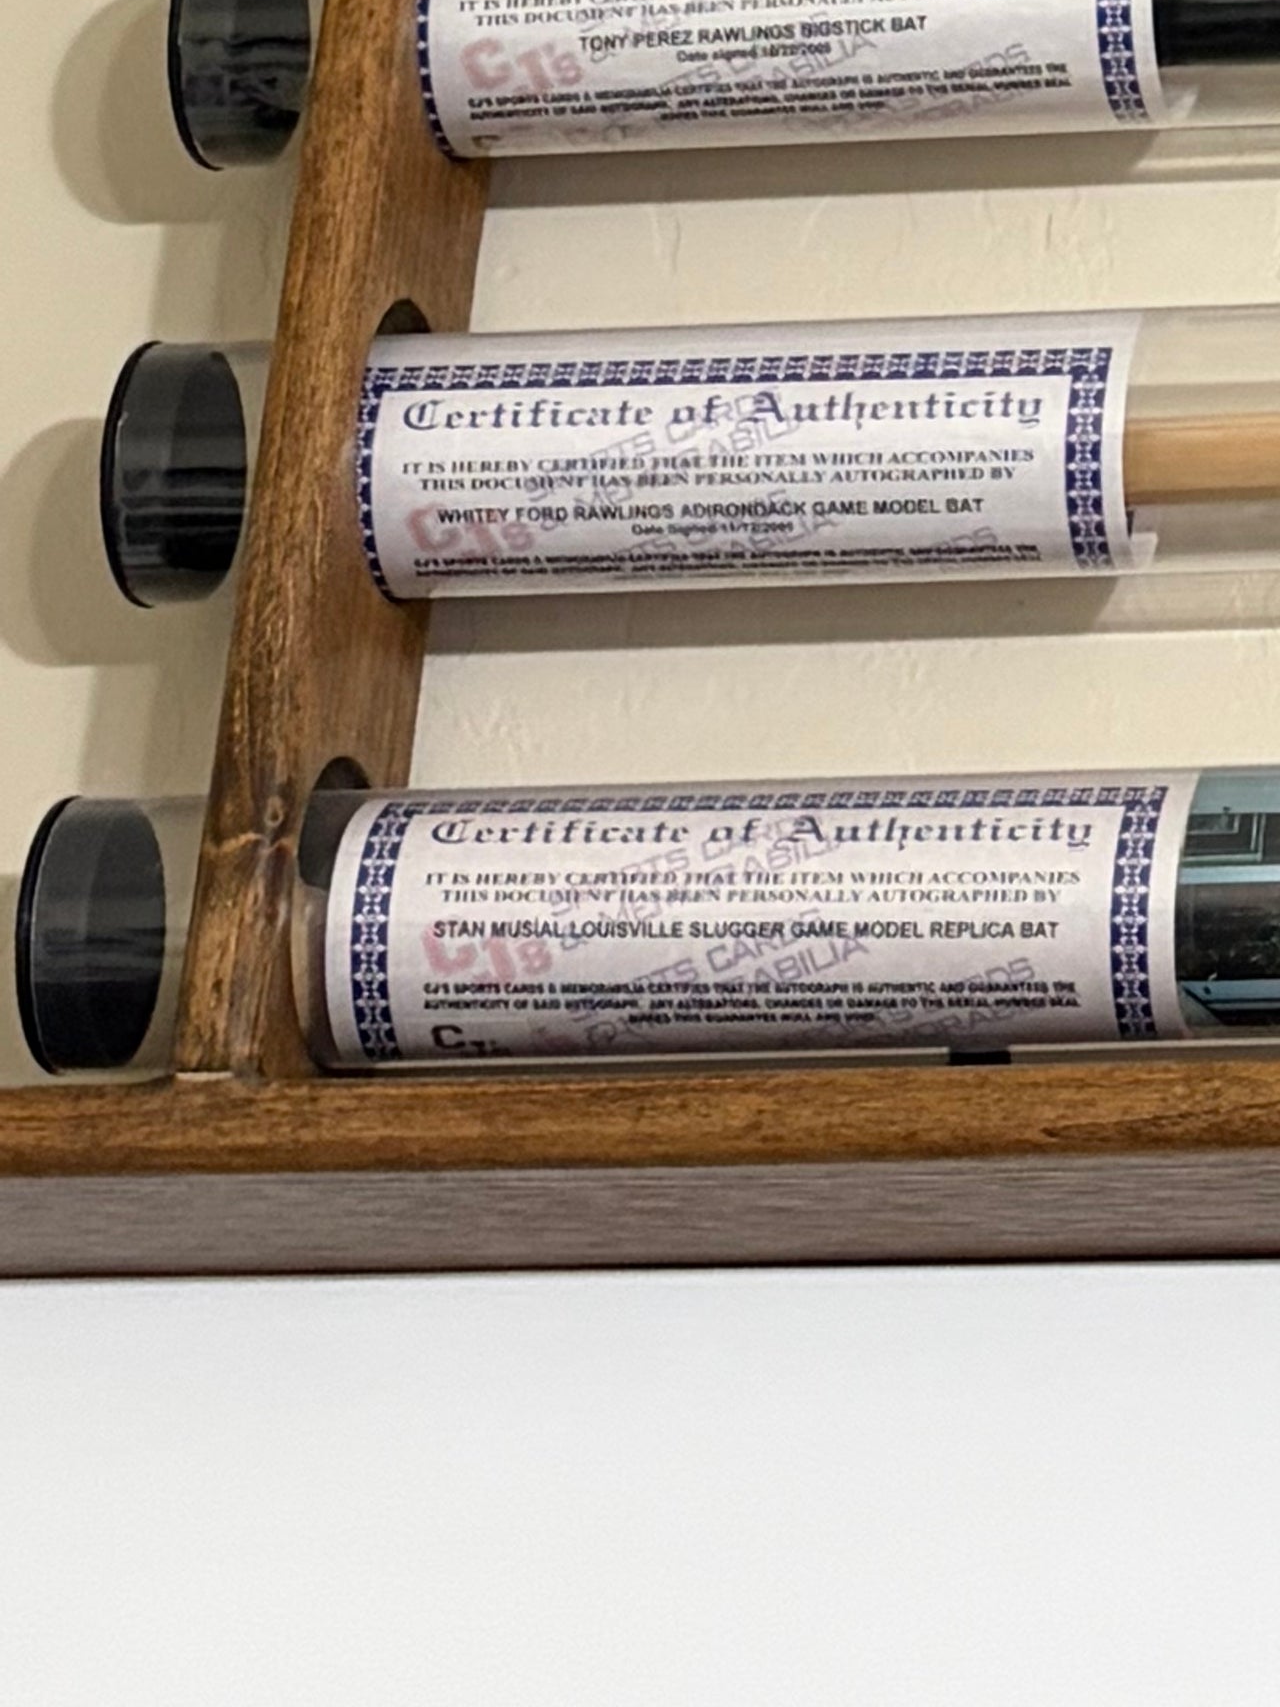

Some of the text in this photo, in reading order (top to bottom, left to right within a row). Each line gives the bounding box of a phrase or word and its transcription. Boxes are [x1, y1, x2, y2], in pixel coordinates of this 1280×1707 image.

[579, 36, 627, 52] TONY
[632, 33, 693, 49] PEREZ
[698, 23, 795, 46] RAWLINGS
[890, 15, 927, 32] BAT
[402, 390, 1043, 431] Certificate of Authenticity
[451, 459, 532, 474] HEREBY
[753, 452, 808, 468] ITEM
[812, 450, 883, 466] WHICH
[886, 447, 1036, 464] ACCOMPANIES
[418, 477, 467, 492] THIS
[830, 466, 986, 484] AUTOGRAPHED
[989, 465, 1017, 481] BY
[437, 497, 985, 525] WHITEY FORD RAWLINGS ADIRONDACK GAME MODEL BAT
[431, 813, 1093, 851] Certificate of Authenticity
[475, 871, 560, 887] HEREBY
[789, 870, 845, 886] ITEM
[850, 870, 925, 886] WHICH
[928, 869, 1082, 886] ACCOMPANIES
[441, 888, 490, 904] THIS
[494, 888, 615, 904] DOCUMENT
[726, 887, 863, 904] PERSONALLY
[866, 887, 1029, 904] AUTOGRAPHED
[1033, 888, 1062, 904] BY
[433, 918, 1060, 940] STAN MUSIAL LOUISVILLE SLUGGER GAME MODEL REPLICA BAT
